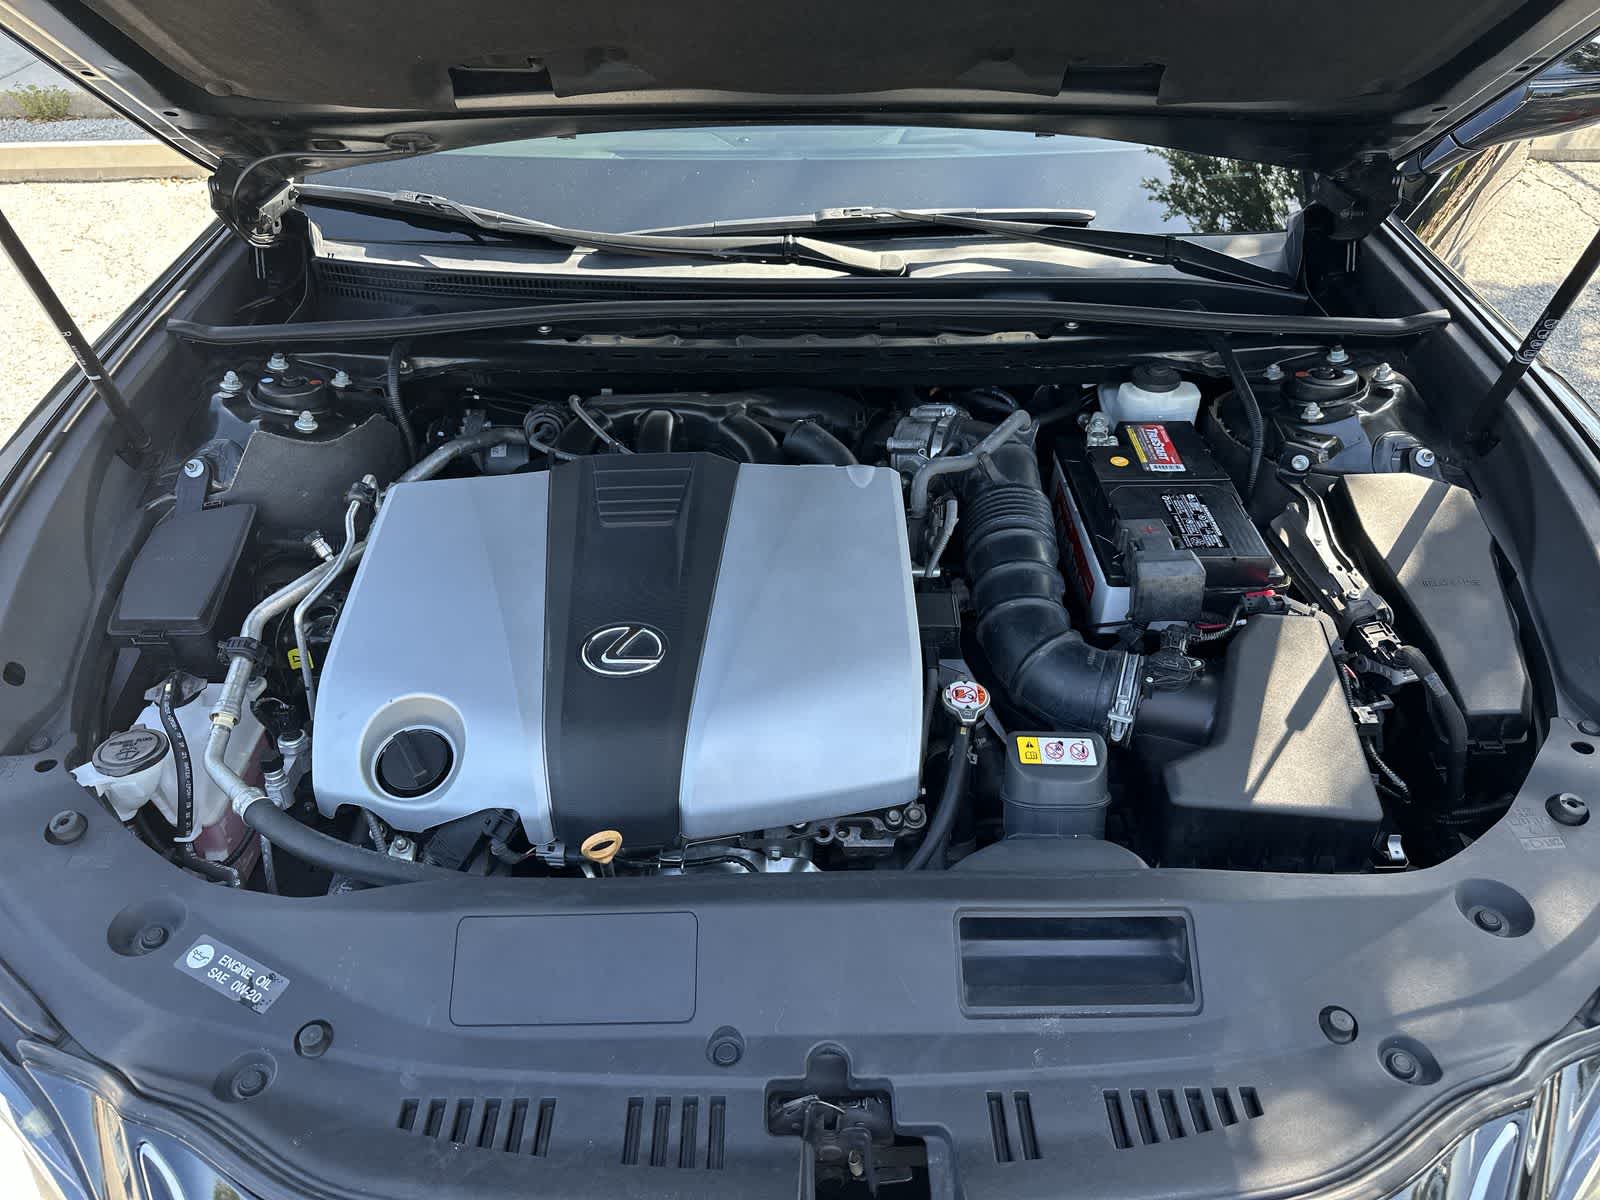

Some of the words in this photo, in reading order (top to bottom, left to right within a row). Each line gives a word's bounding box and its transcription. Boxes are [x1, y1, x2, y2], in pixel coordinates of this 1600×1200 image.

[207, 967, 230, 985] SAE
[230, 980, 263, 1004] 0W-20
[218, 955, 255, 980] ENGINE
[255, 975, 273, 991] OIL
